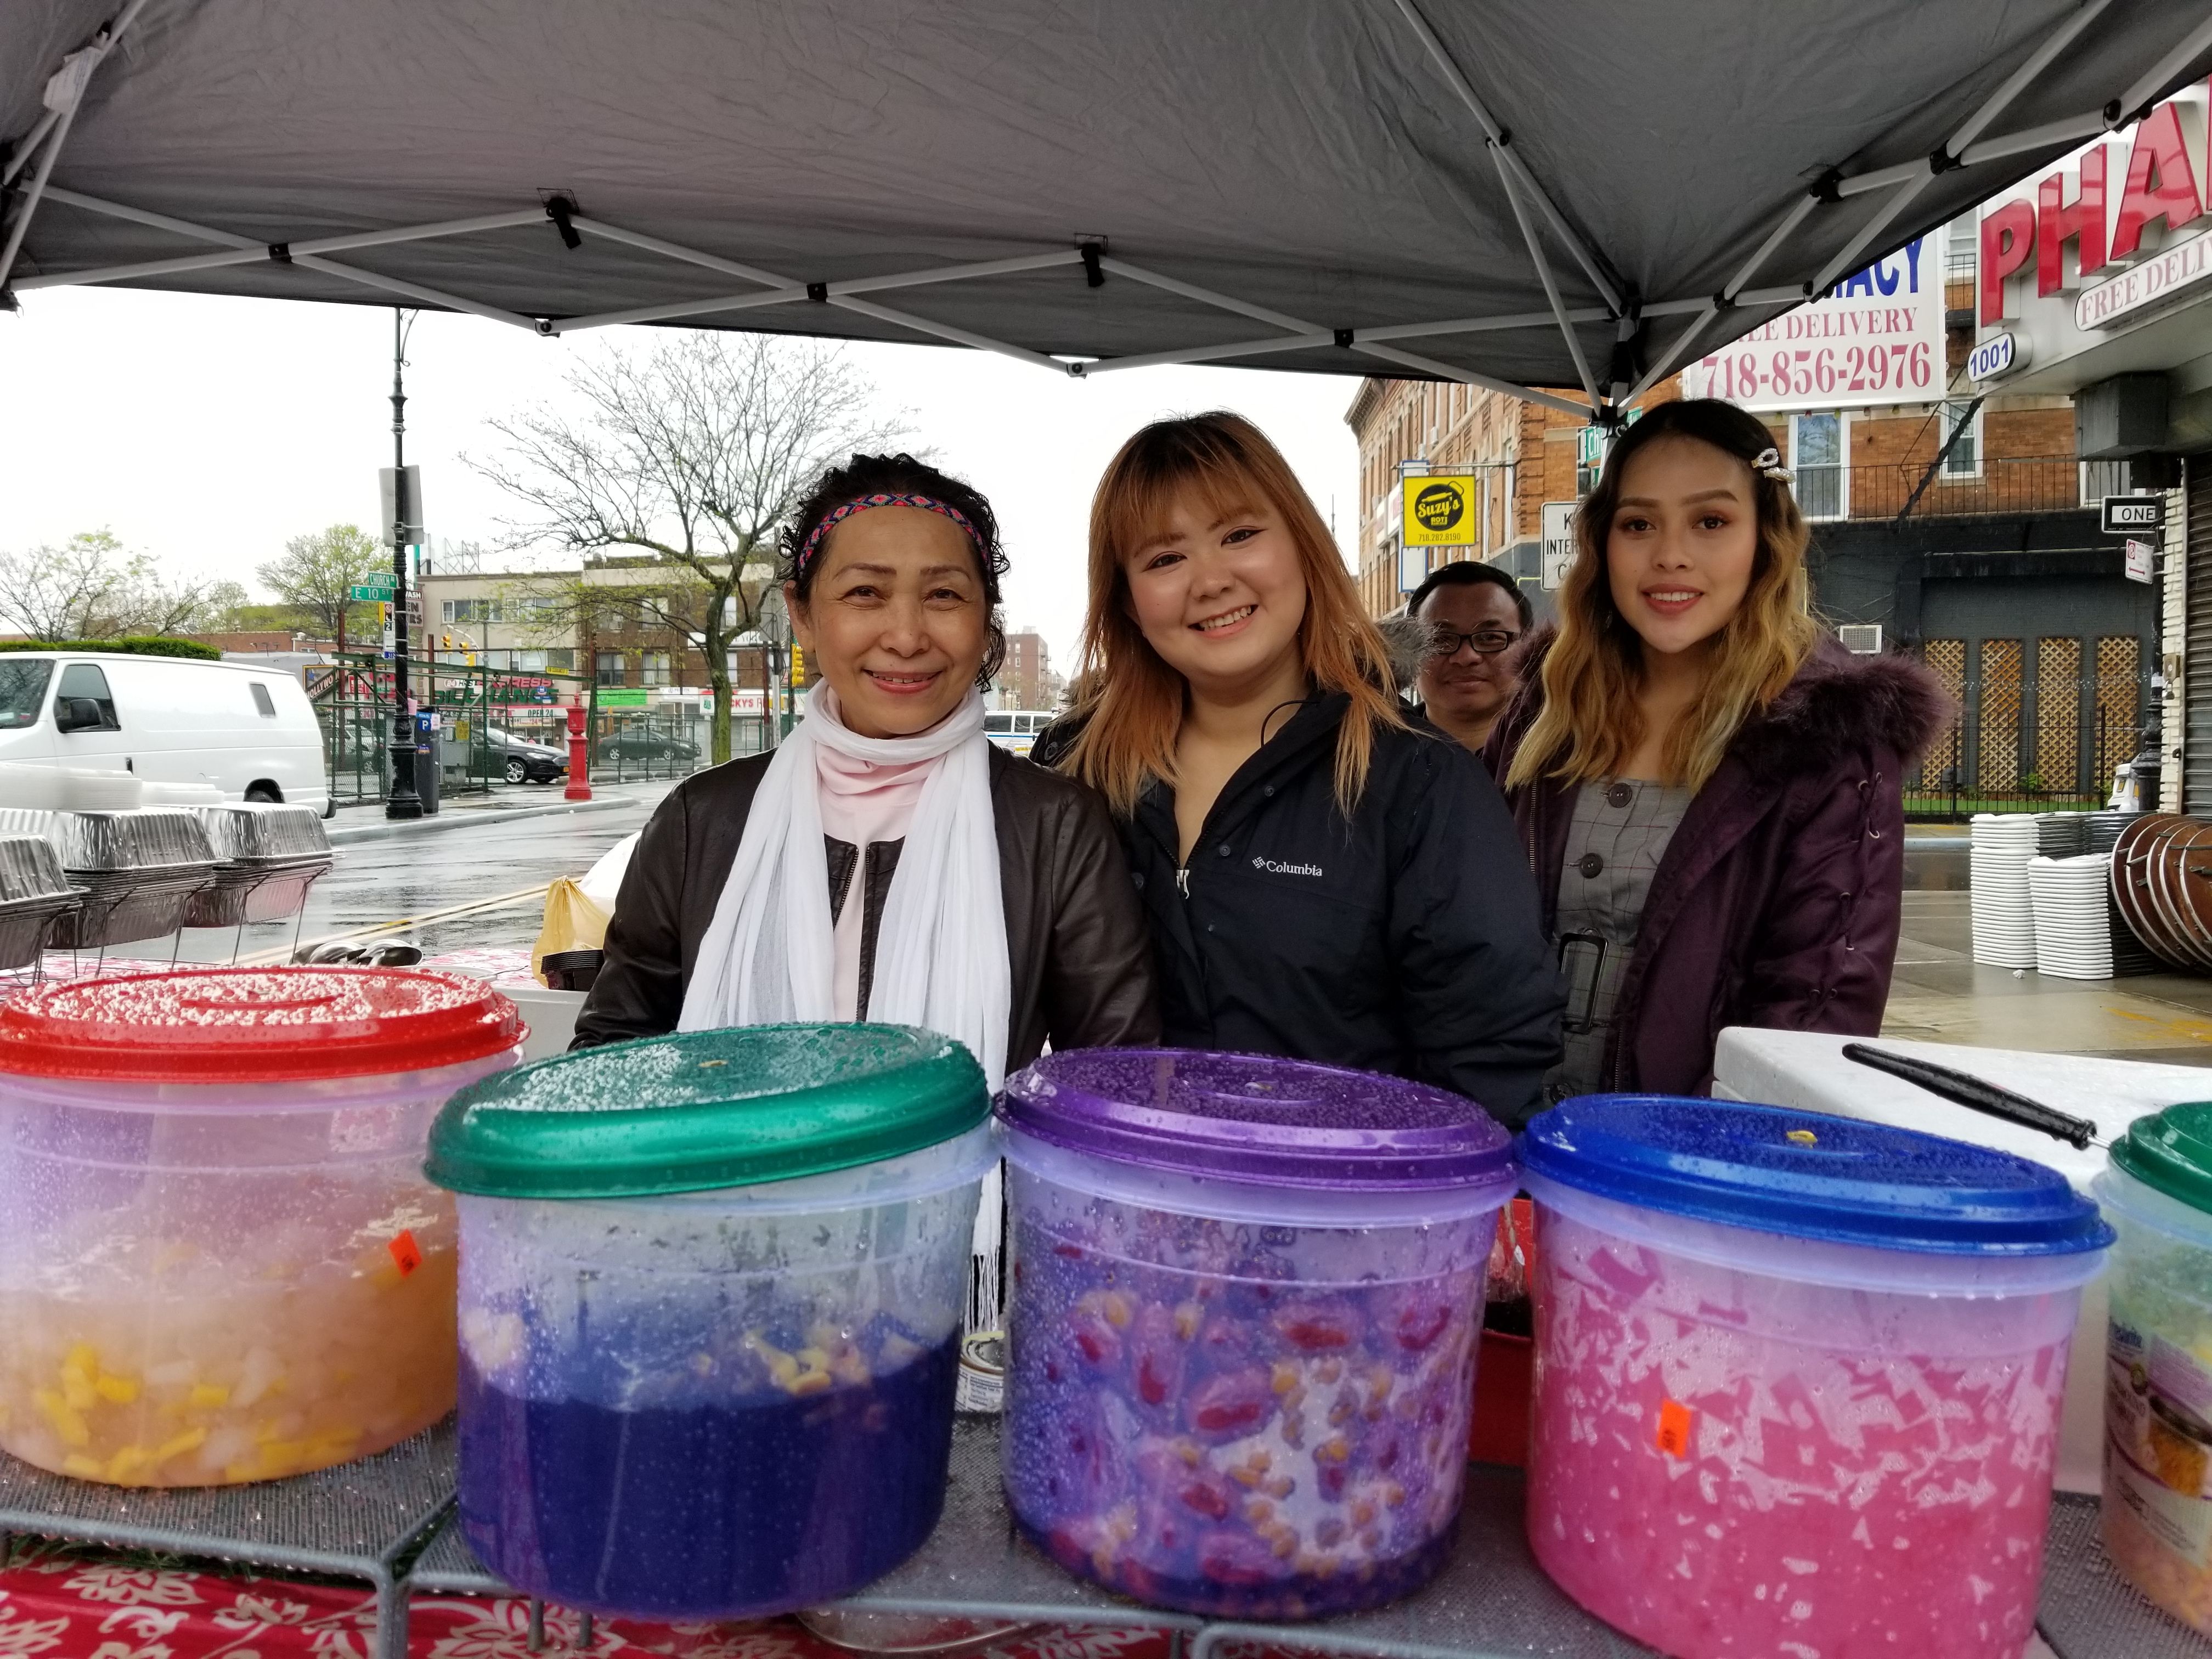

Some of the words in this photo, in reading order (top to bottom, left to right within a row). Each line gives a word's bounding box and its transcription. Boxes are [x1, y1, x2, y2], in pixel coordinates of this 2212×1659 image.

[1981, 74, 2212, 328] PHA
[2080, 273, 2138, 326] FREE
[1786, 307, 1918, 340] DELIVERY
[1971, 338, 2008, 377] 1001
[1702, 341, 1931, 399] 718-856-2976
[1589, 426, 1602, 456] Ch
[1418, 496, 1460, 518] Suzy's
[2121, 507, 2155, 521] ONE
[1419, 533, 1461, 542] 718.282.8190
[370, 573, 390, 587] CHURCH
[355, 587, 362, 599] E
[368, 588, 379, 600] 10
[528, 709, 544, 718] OPEN
[1266, 860, 1322, 877] Columbia
